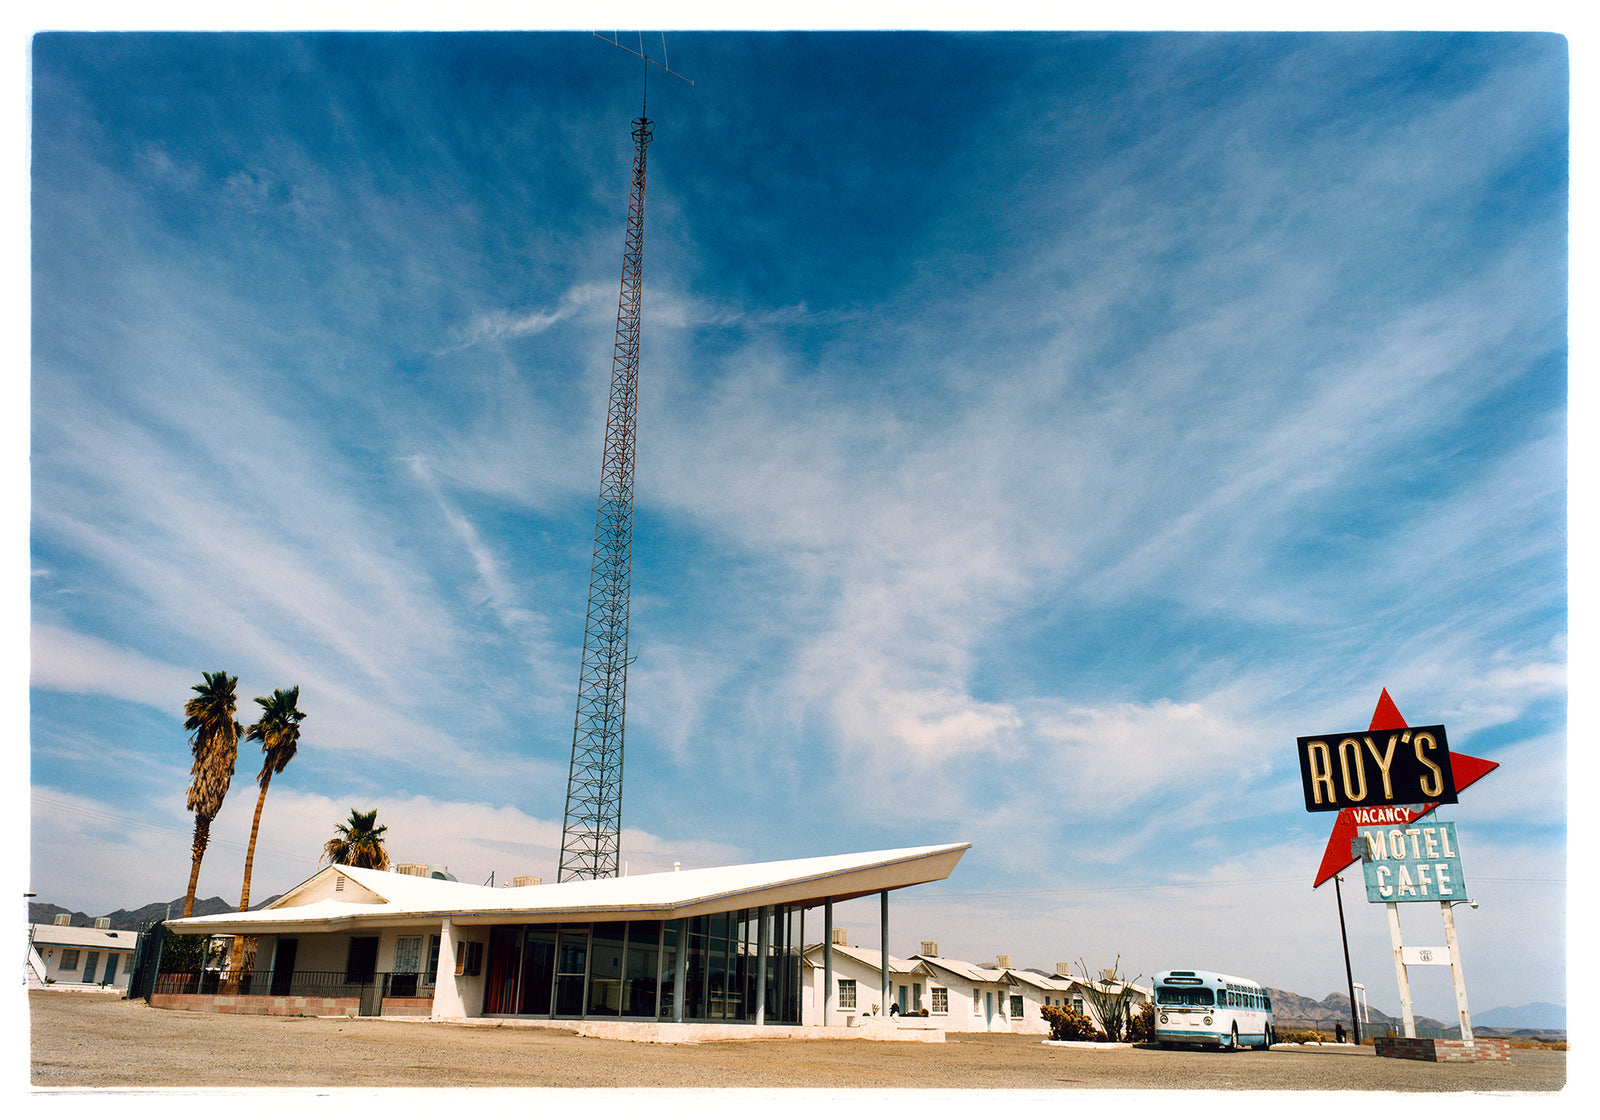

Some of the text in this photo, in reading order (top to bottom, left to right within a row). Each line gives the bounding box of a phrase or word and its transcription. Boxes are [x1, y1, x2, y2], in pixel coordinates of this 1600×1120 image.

[1307, 730, 1444, 804] ROY'S
[1353, 807, 1410, 823] VACANCY
[1364, 827, 1455, 860] MOTEL
[1376, 863, 1453, 897] CAFE
